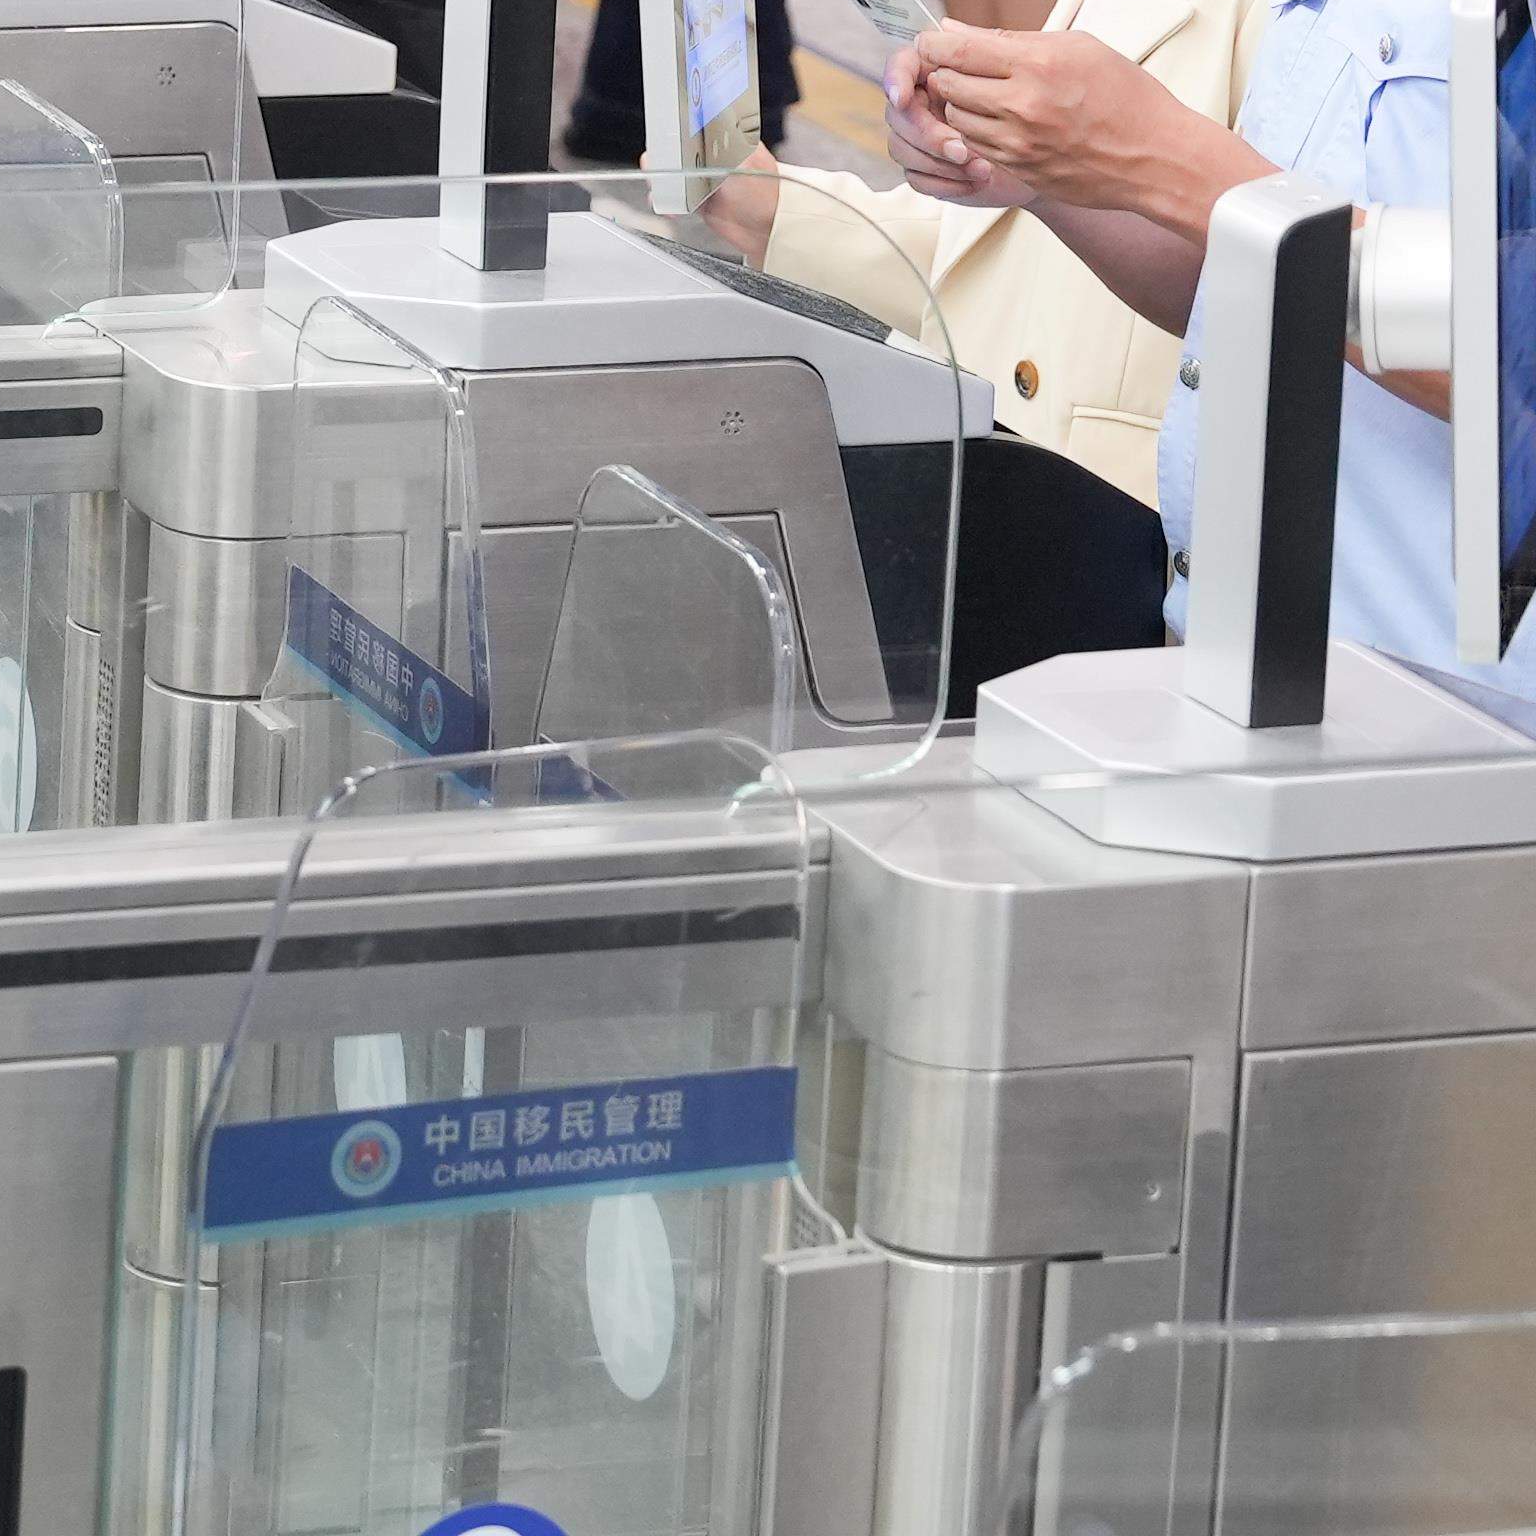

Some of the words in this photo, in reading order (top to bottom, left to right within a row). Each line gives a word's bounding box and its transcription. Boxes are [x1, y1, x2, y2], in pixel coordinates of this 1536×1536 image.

[425, 1090, 683, 1156] 中国移民管理
[432, 1159, 507, 1187] CHINA
[517, 1140, 672, 1176] IMMIGRATION
